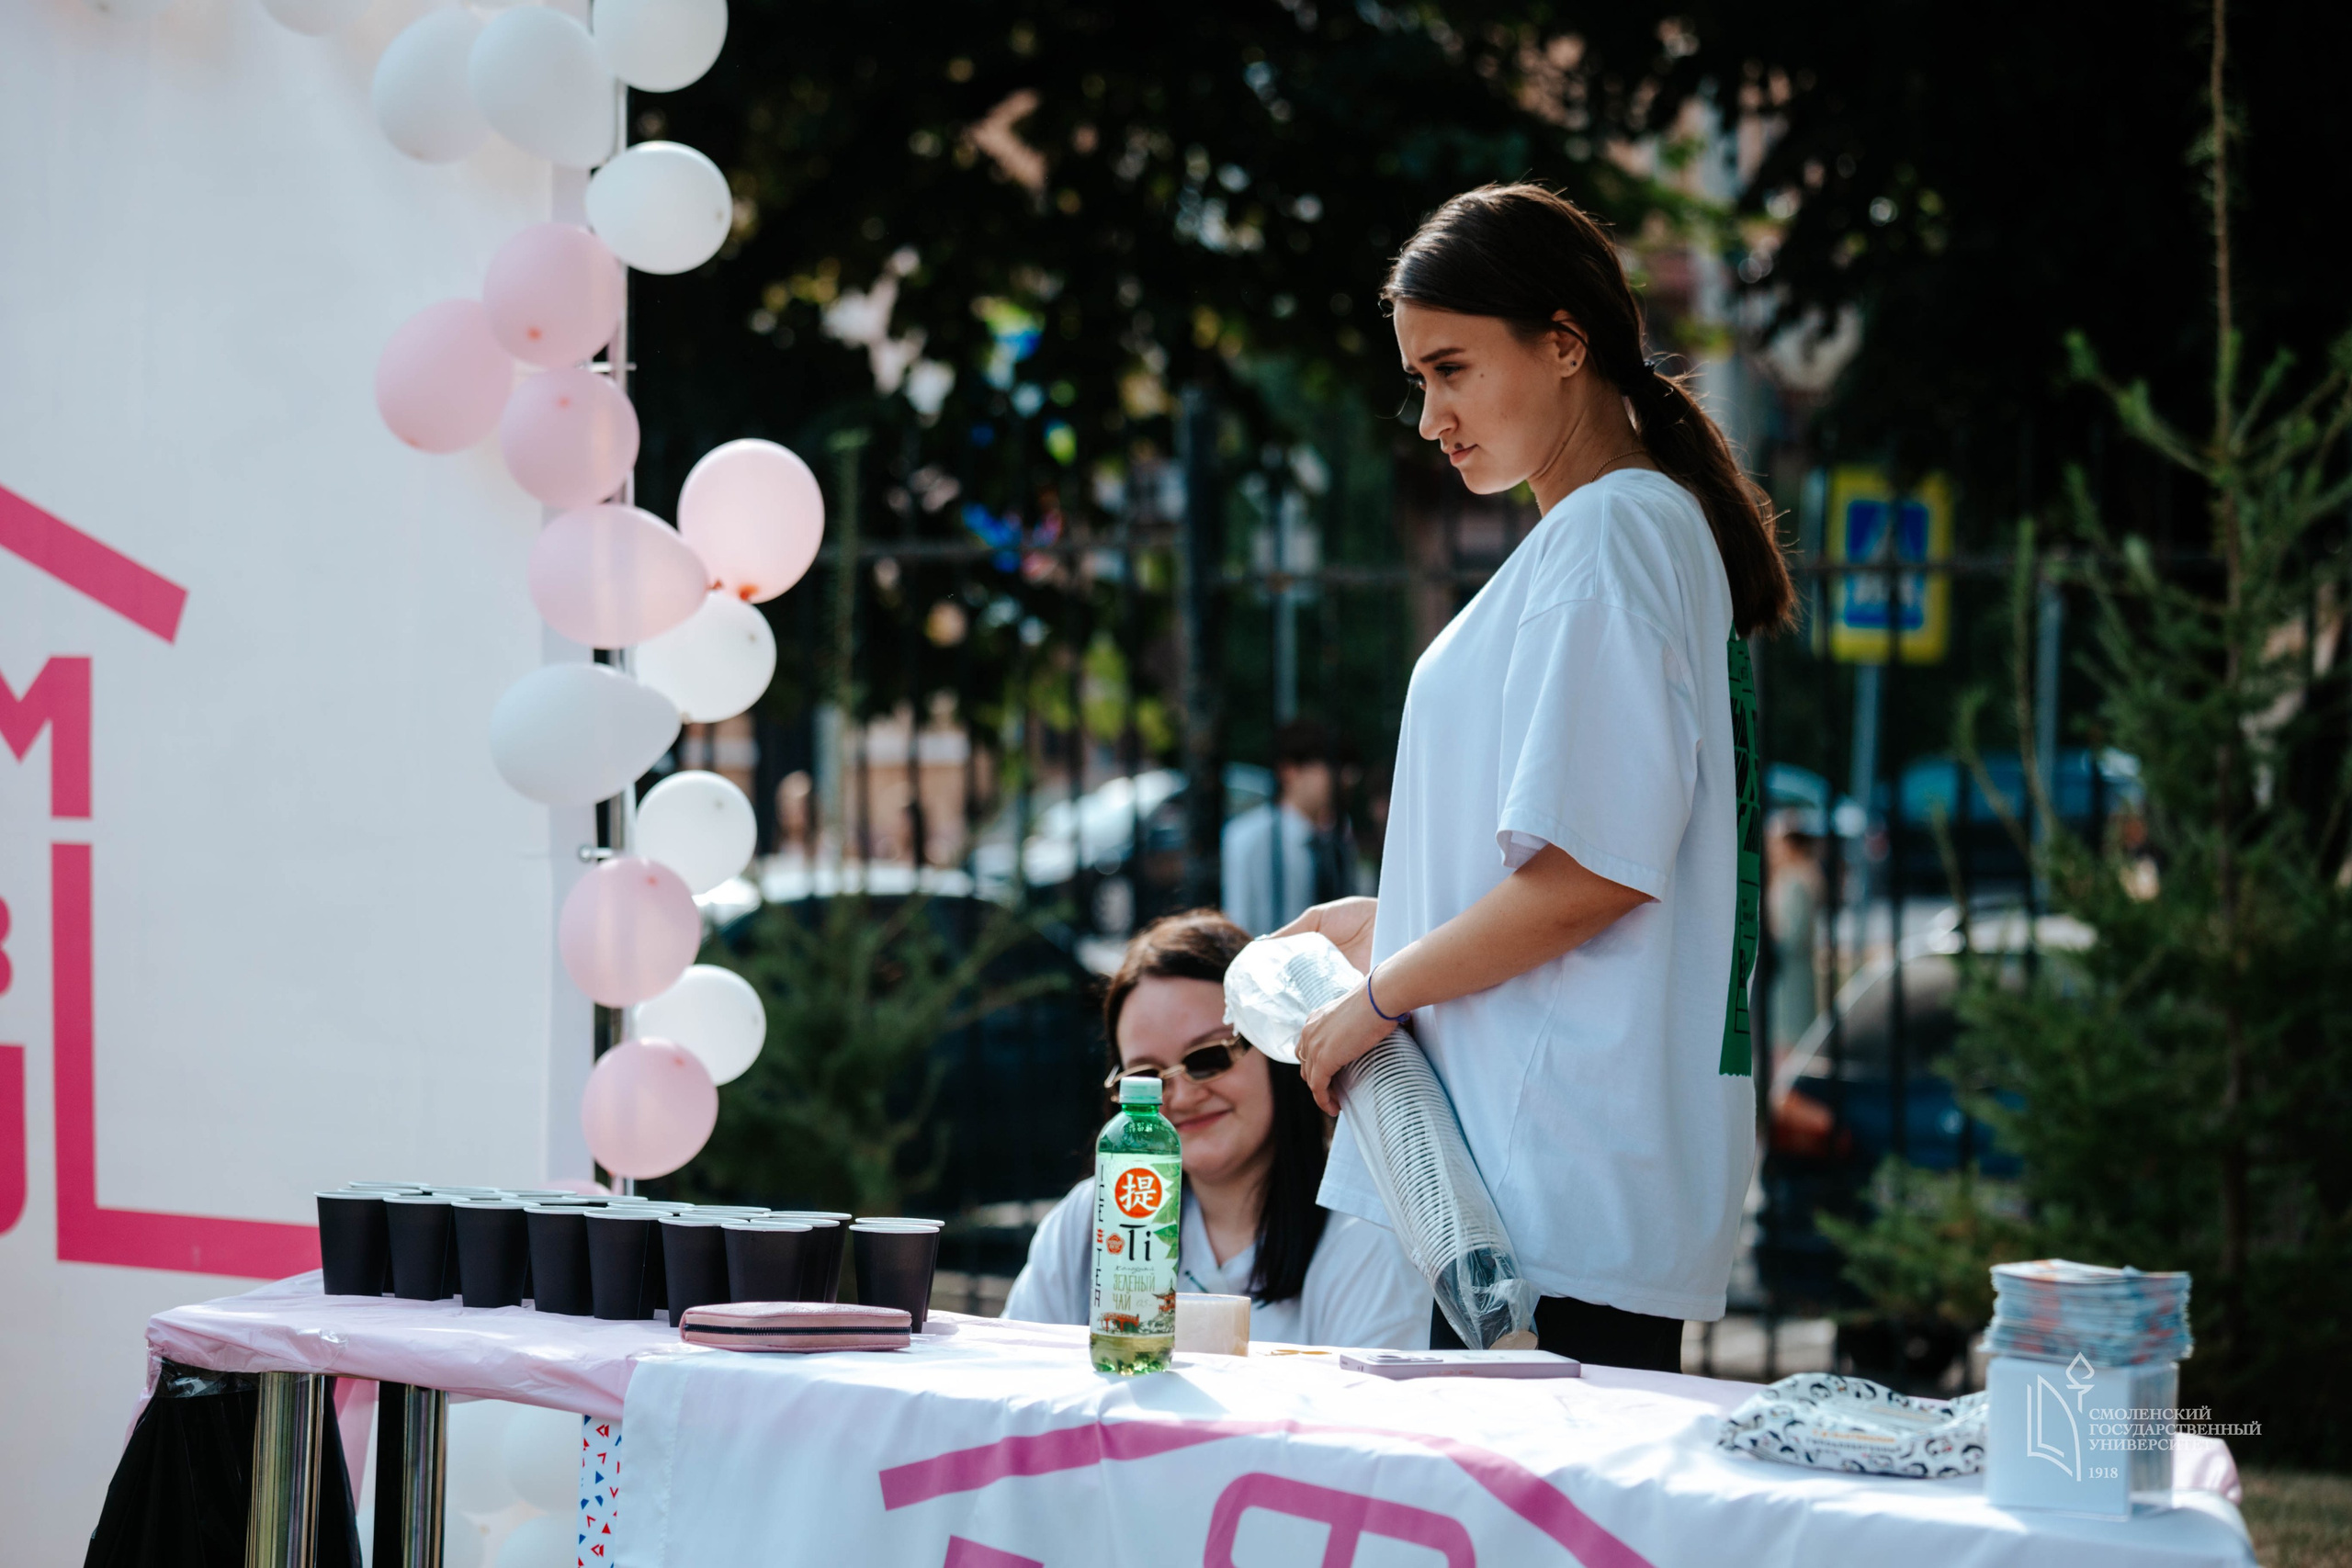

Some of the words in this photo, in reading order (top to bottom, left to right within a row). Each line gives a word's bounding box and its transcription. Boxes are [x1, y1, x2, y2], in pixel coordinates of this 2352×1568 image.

[1119, 1173, 1159, 1212] 提
[1119, 1224, 1152, 1261] Ti
[1112, 1292, 1132, 1311] ЧАЙ
